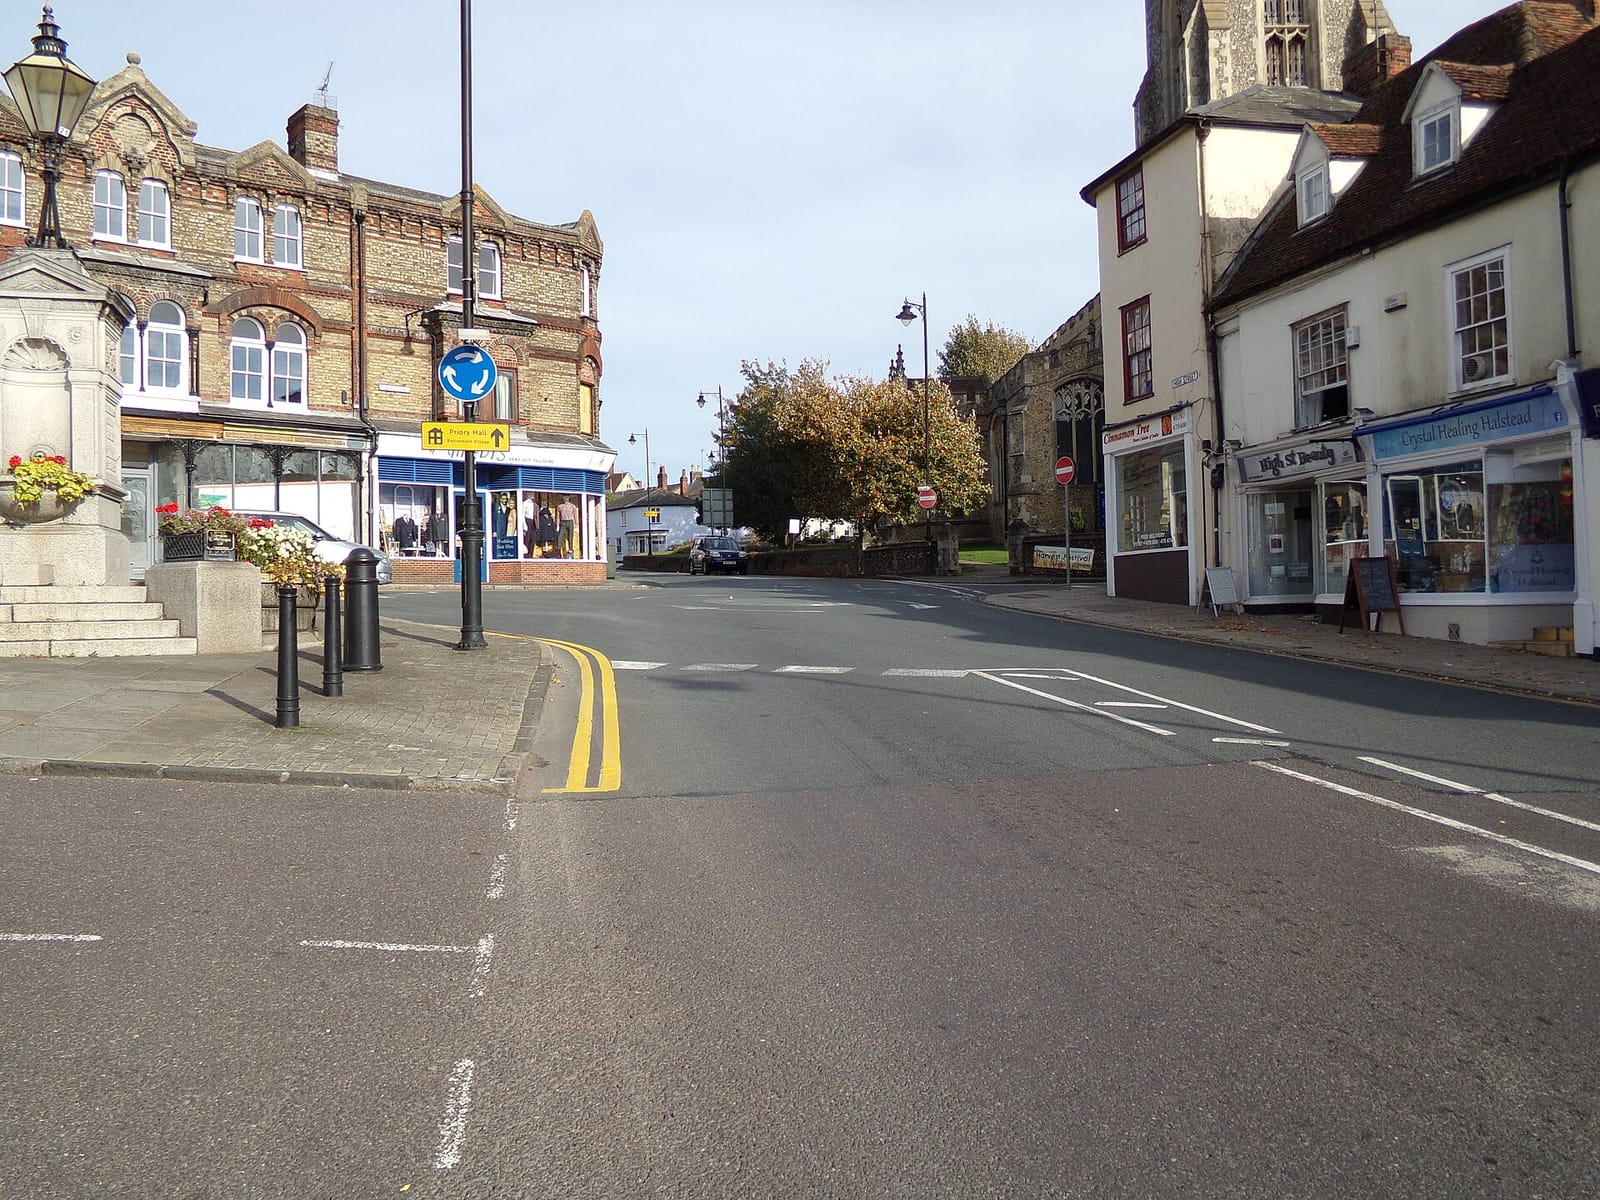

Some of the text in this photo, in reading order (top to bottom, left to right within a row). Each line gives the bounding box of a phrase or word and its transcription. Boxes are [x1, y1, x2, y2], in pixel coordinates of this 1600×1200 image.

[1104, 423, 1150, 445] Cinnamon Tree
[1401, 403, 1533, 450] Crystal Healing Halstead
[1259, 443, 1336, 476] High St Beauty
[1036, 550, 1061, 560] Harvest
